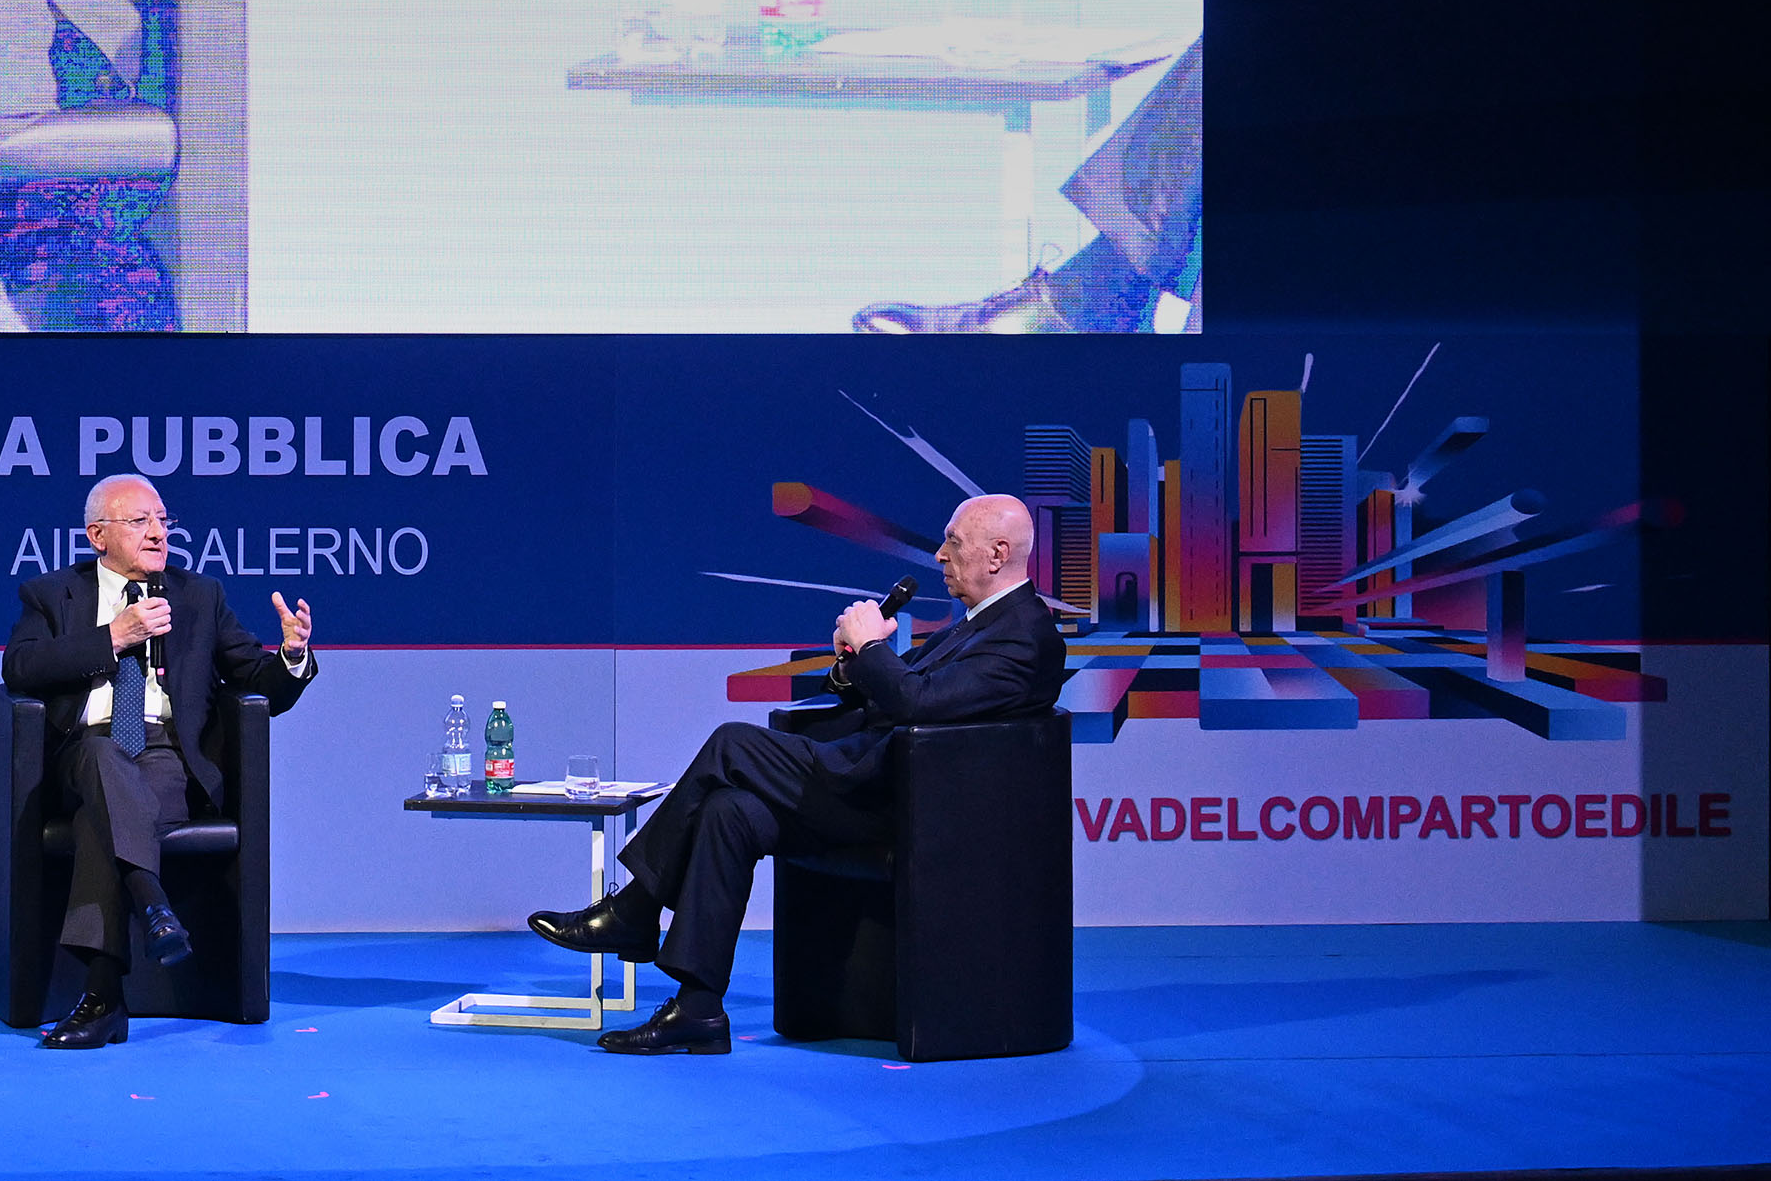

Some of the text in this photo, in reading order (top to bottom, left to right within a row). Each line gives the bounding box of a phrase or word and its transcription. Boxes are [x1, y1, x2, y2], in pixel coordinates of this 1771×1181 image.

[79, 416, 488, 476] PUBBLICA
[167, 527, 429, 576] SALERNO
[1074, 793, 1732, 843] VADELCOMPARTOEDILE
